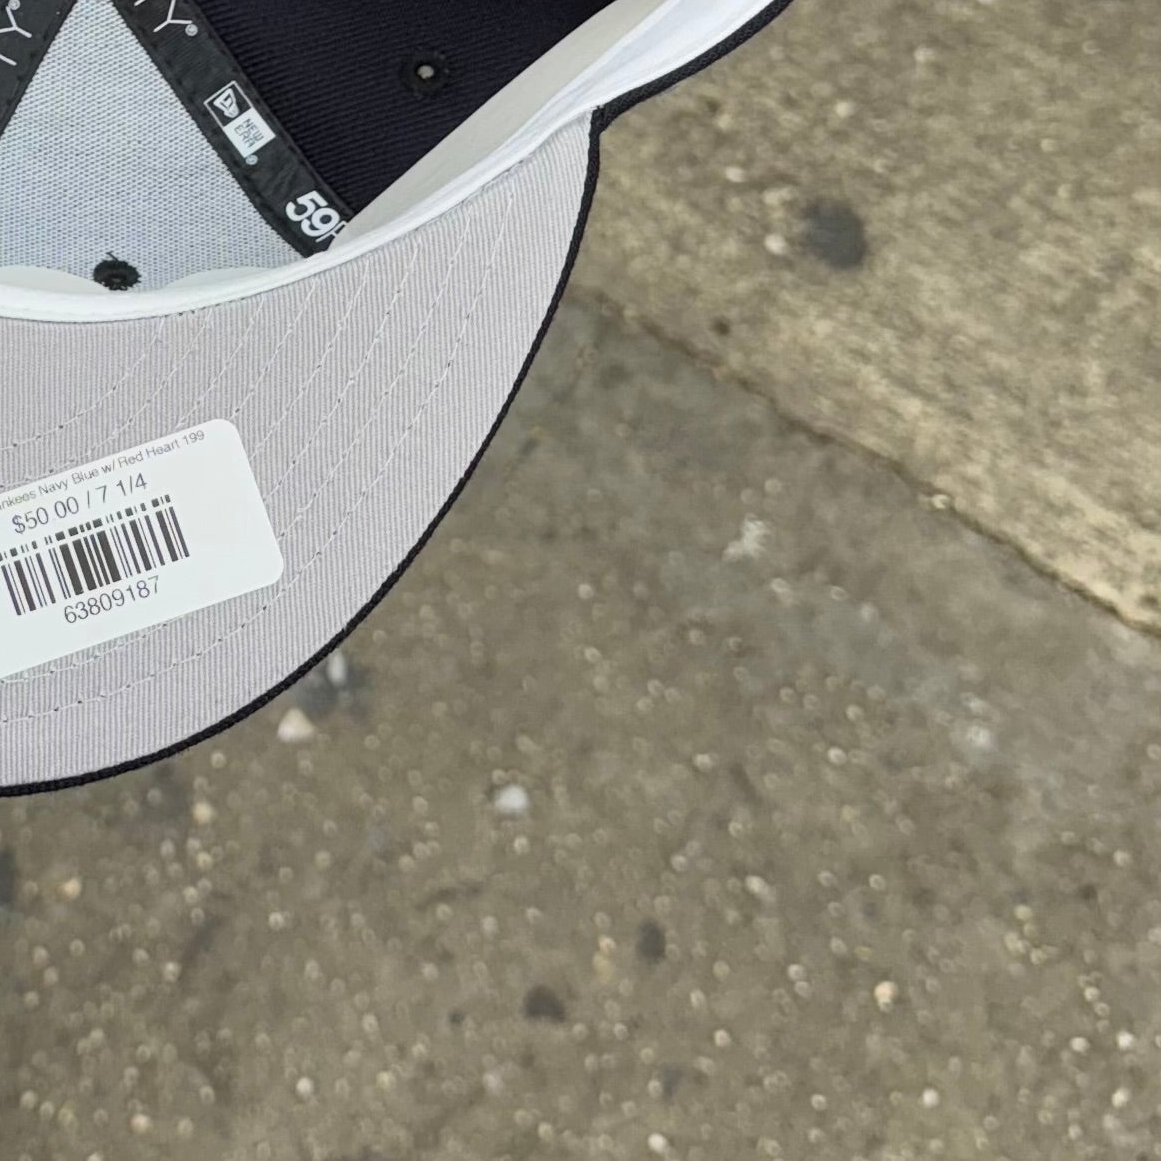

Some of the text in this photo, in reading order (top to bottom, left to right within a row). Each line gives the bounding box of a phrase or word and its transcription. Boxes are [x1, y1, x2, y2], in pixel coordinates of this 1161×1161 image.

[233, 123, 256, 148] ERA
[242, 117, 263, 142] NEW
[39, 478, 69, 498] Navy
[71, 466, 99, 485] Blue
[117, 451, 144, 469] Red
[146, 439, 180, 459] Heart
[182, 430, 206, 445] 199
[11, 496, 80, 535] $5000
[95, 485, 108, 504] 7
[116, 472, 148, 497] 1/4
[63, 575, 161, 625] 63809187
